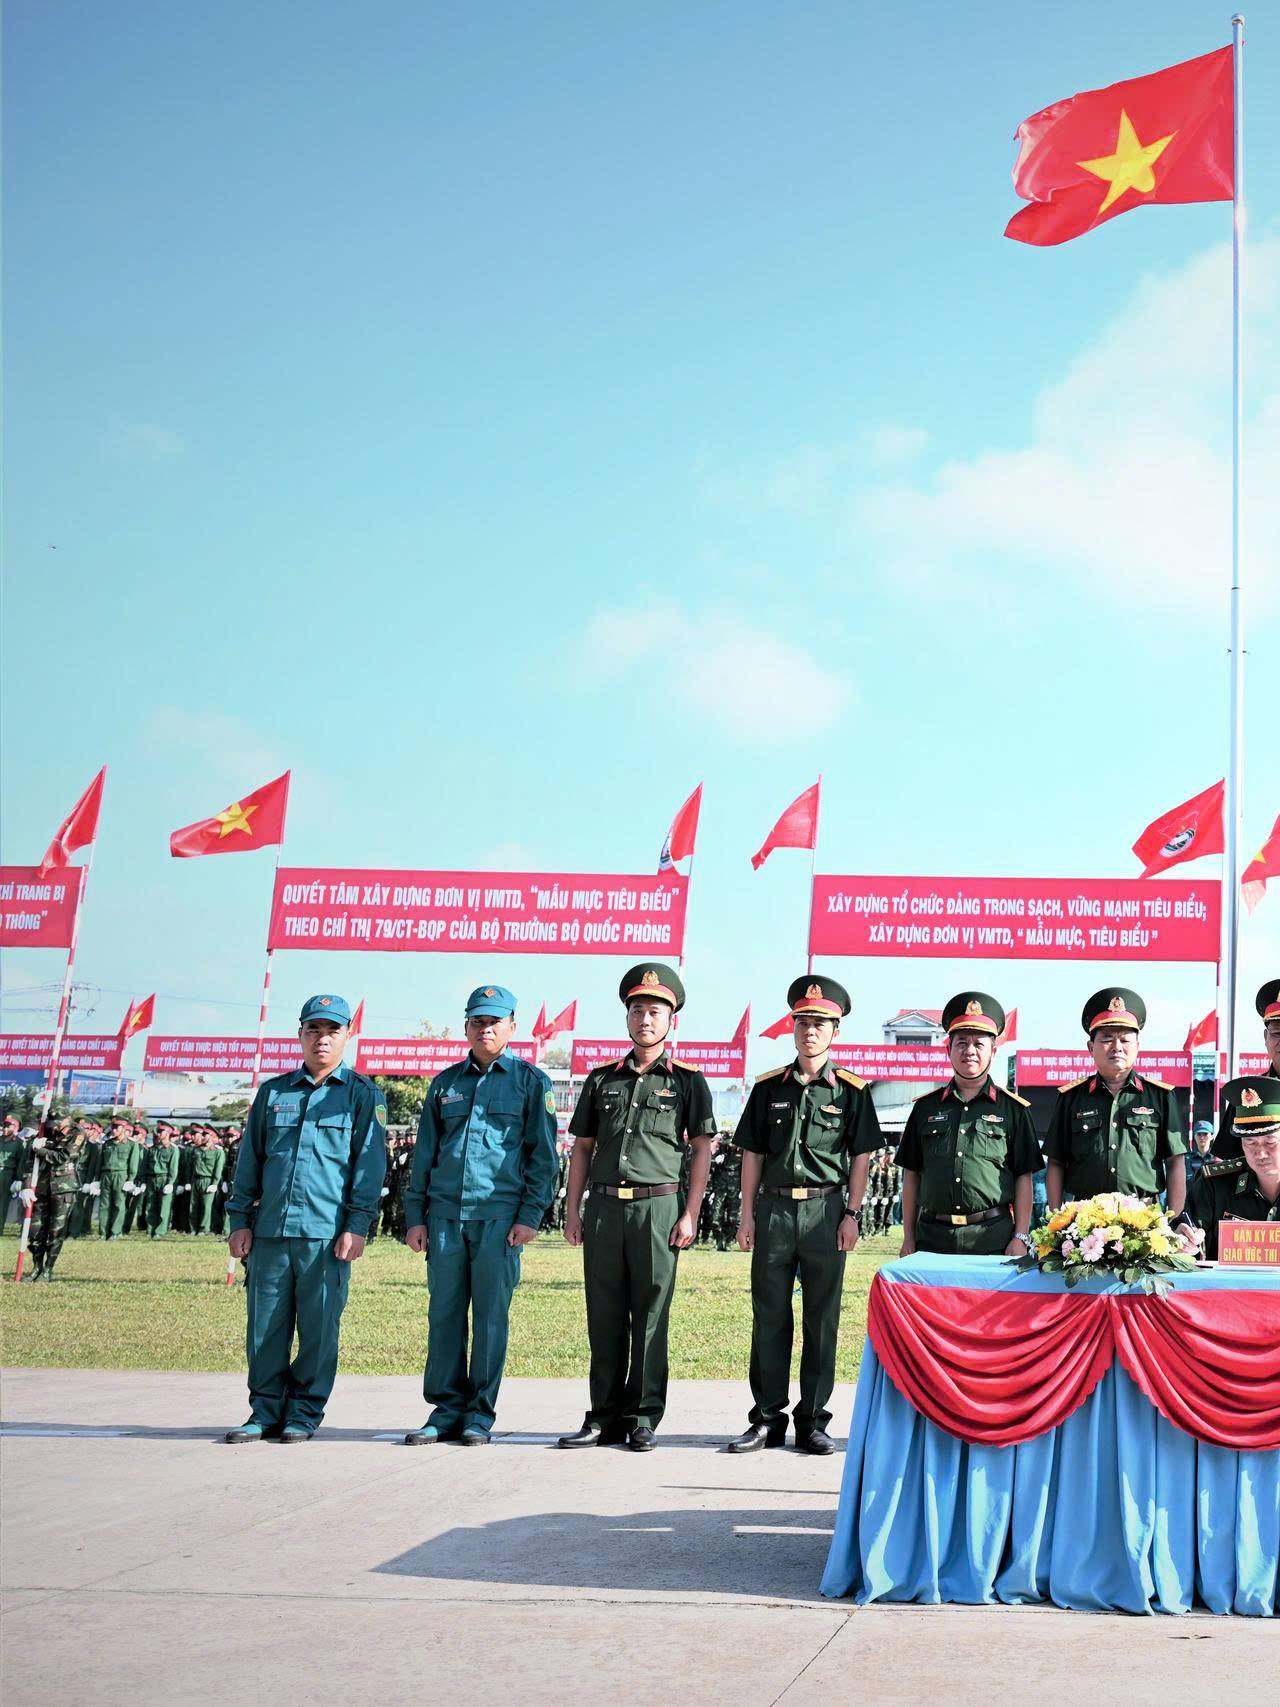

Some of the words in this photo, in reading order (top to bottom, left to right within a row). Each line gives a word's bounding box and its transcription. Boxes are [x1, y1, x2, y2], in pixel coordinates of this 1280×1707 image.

[16, 885, 51, 900] TRANG
[53, 885, 66, 904] BỊ
[282, 880, 326, 906] QUYẾT
[330, 882, 359, 904] TÂM
[362, 883, 390, 905] XÂY
[393, 886, 431, 911] DỰNG
[434, 887, 464, 907] ĐƠN
[468, 888, 481, 912] VỊ
[484, 890, 525, 911] VMTD,
[572, 889, 604, 913] MỰC
[607, 888, 636, 910] TIÊU
[828, 892, 851, 912] XÂY
[854, 893, 888, 918] DỰNG
[891, 889, 909, 914] TỔ
[910, 893, 944, 914] CHỨC
[947, 892, 980, 915] ĐẢNG
[984, 898, 1024, 916] TRONG
[1028, 899, 1064, 921] SẠCH,
[1068, 895, 1100, 917] VỮNG
[1104, 900, 1139, 922] MẠNH
[1143, 897, 1171, 918] TIÊU
[285, 917, 319, 936] THEO
[322, 912, 348, 936] CHỈ
[350, 918, 371, 941] THỊ
[375, 919, 446, 941] 79/CT-BQP
[450, 915, 477, 939] CỦA
[481, 918, 499, 944] BỘ
[504, 916, 557, 942] TRƯỞNG
[561, 920, 580, 946] BỘ
[584, 916, 620, 942] QUỐC
[623, 920, 671, 943] PHÒNG
[868, 922, 894, 942] XÂY
[896, 923, 930, 948] DỰNG
[933, 924, 959, 944] ĐƠN
[962, 927, 974, 949] VỊ
[978, 928, 1014, 948] VMTD,
[1056, 926, 1085, 950] MỰC,
[1089, 926, 1117, 946] TIÊU
[1254, 1227, 1266, 1243] KÝ
[1223, 1248, 1242, 1261] GIAO
[1265, 1249, 1278, 1262] THI
